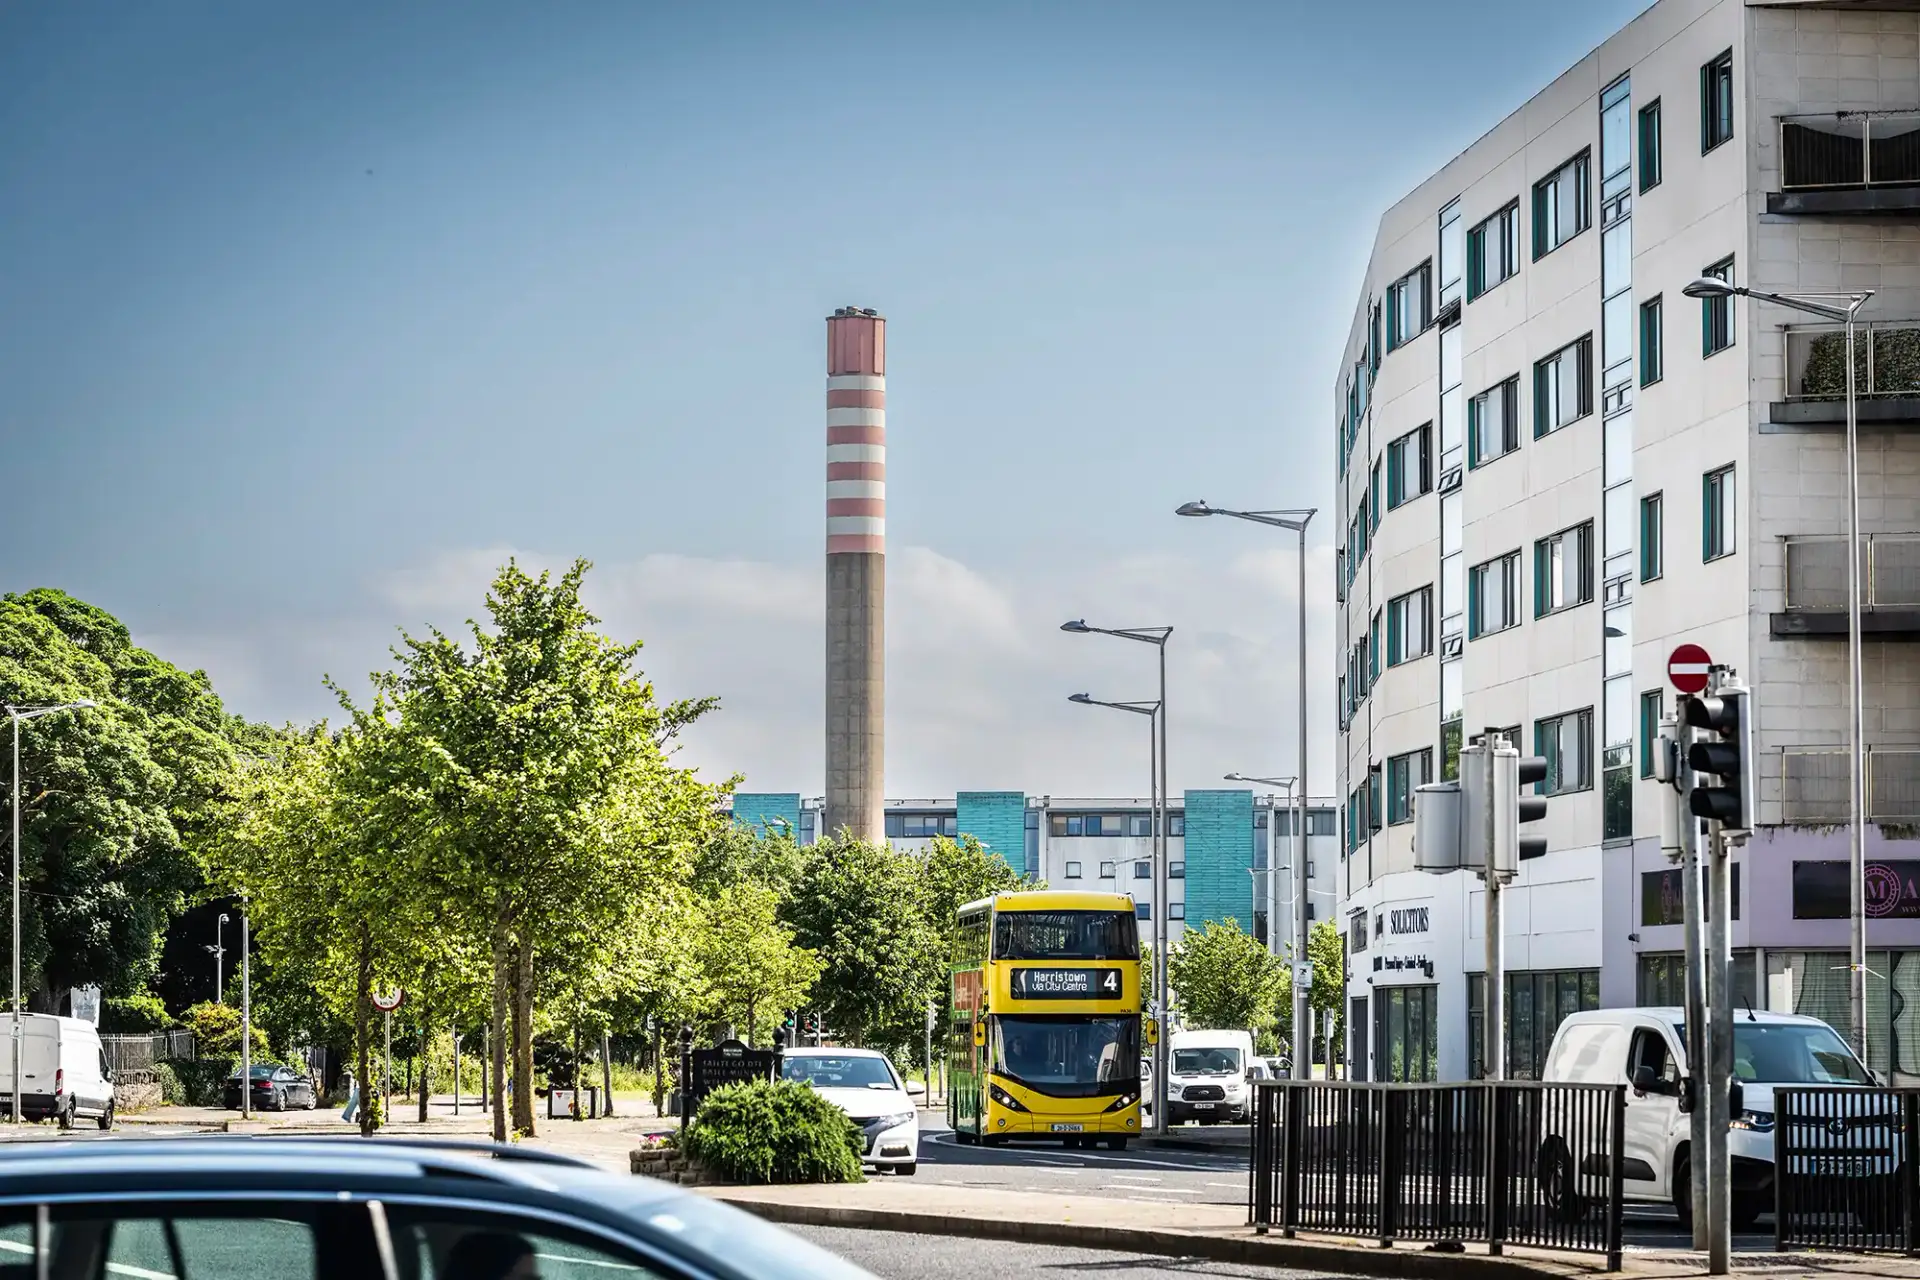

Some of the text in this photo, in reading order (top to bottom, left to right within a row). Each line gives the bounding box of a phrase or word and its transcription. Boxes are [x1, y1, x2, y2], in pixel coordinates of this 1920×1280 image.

[1390, 907, 1429, 935] SOLICITORS
[1034, 971, 1086, 982] Harristown
[1104, 971, 1117, 991] 4
[1032, 981, 1087, 991] via City Centre
